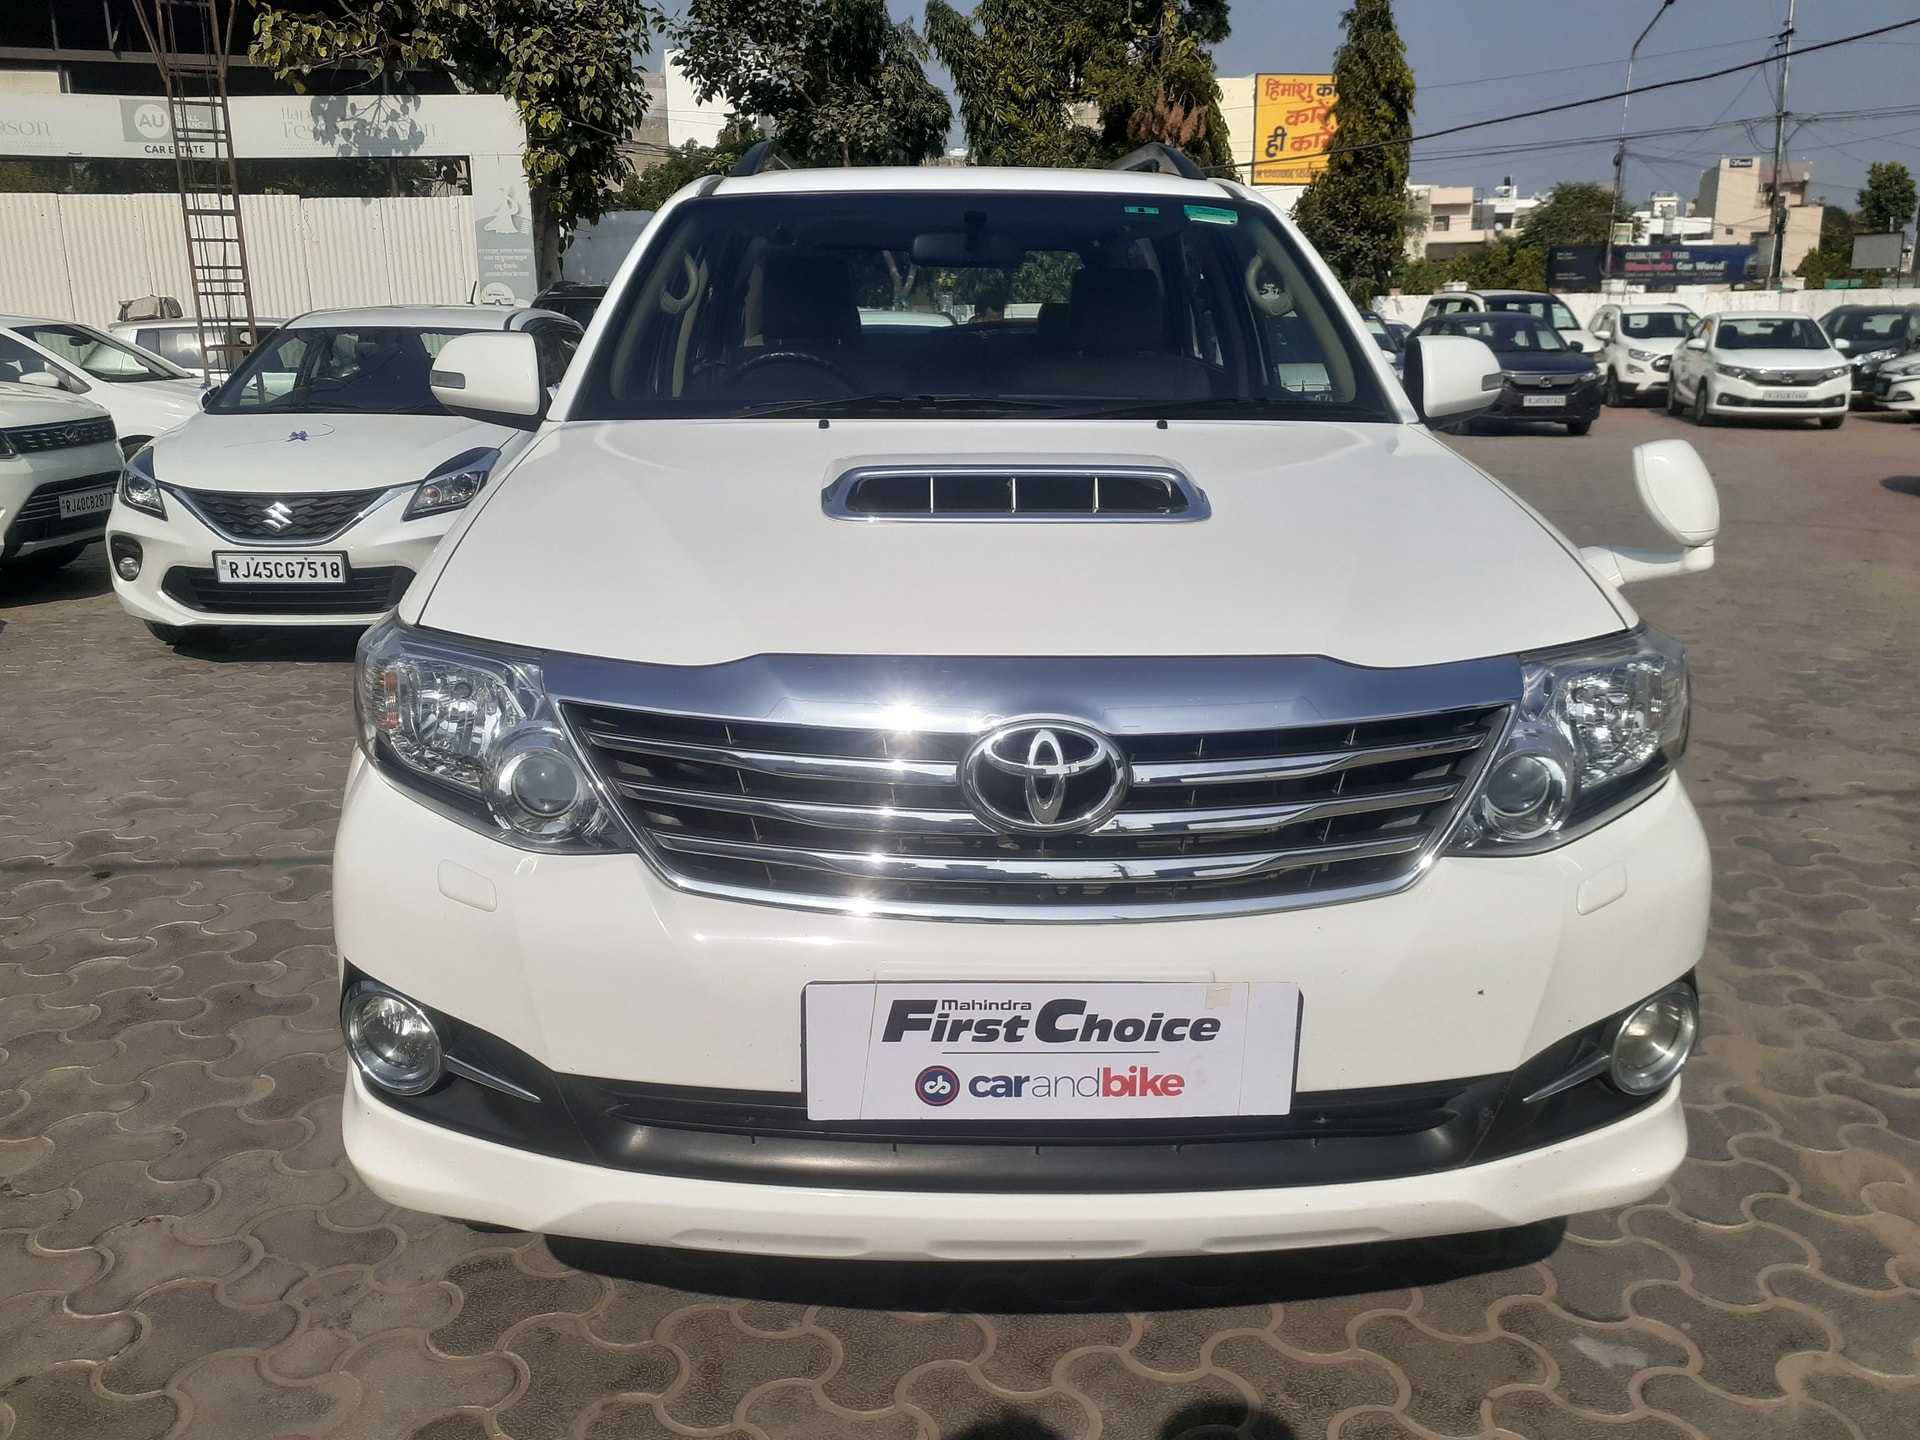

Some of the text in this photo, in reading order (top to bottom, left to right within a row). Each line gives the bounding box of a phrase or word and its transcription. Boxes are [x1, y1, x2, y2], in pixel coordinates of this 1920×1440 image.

[1265, 77, 1314, 104] हिमांशु
[138, 113, 165, 128] AU
[144, 144, 206, 154] CAR ETATE
[1265, 126, 1287, 158] ही
[229, 561, 341, 579] RJ45CG7518
[882, 998, 1222, 1043] First Choice
[968, 1065, 1185, 1098] carandbike
